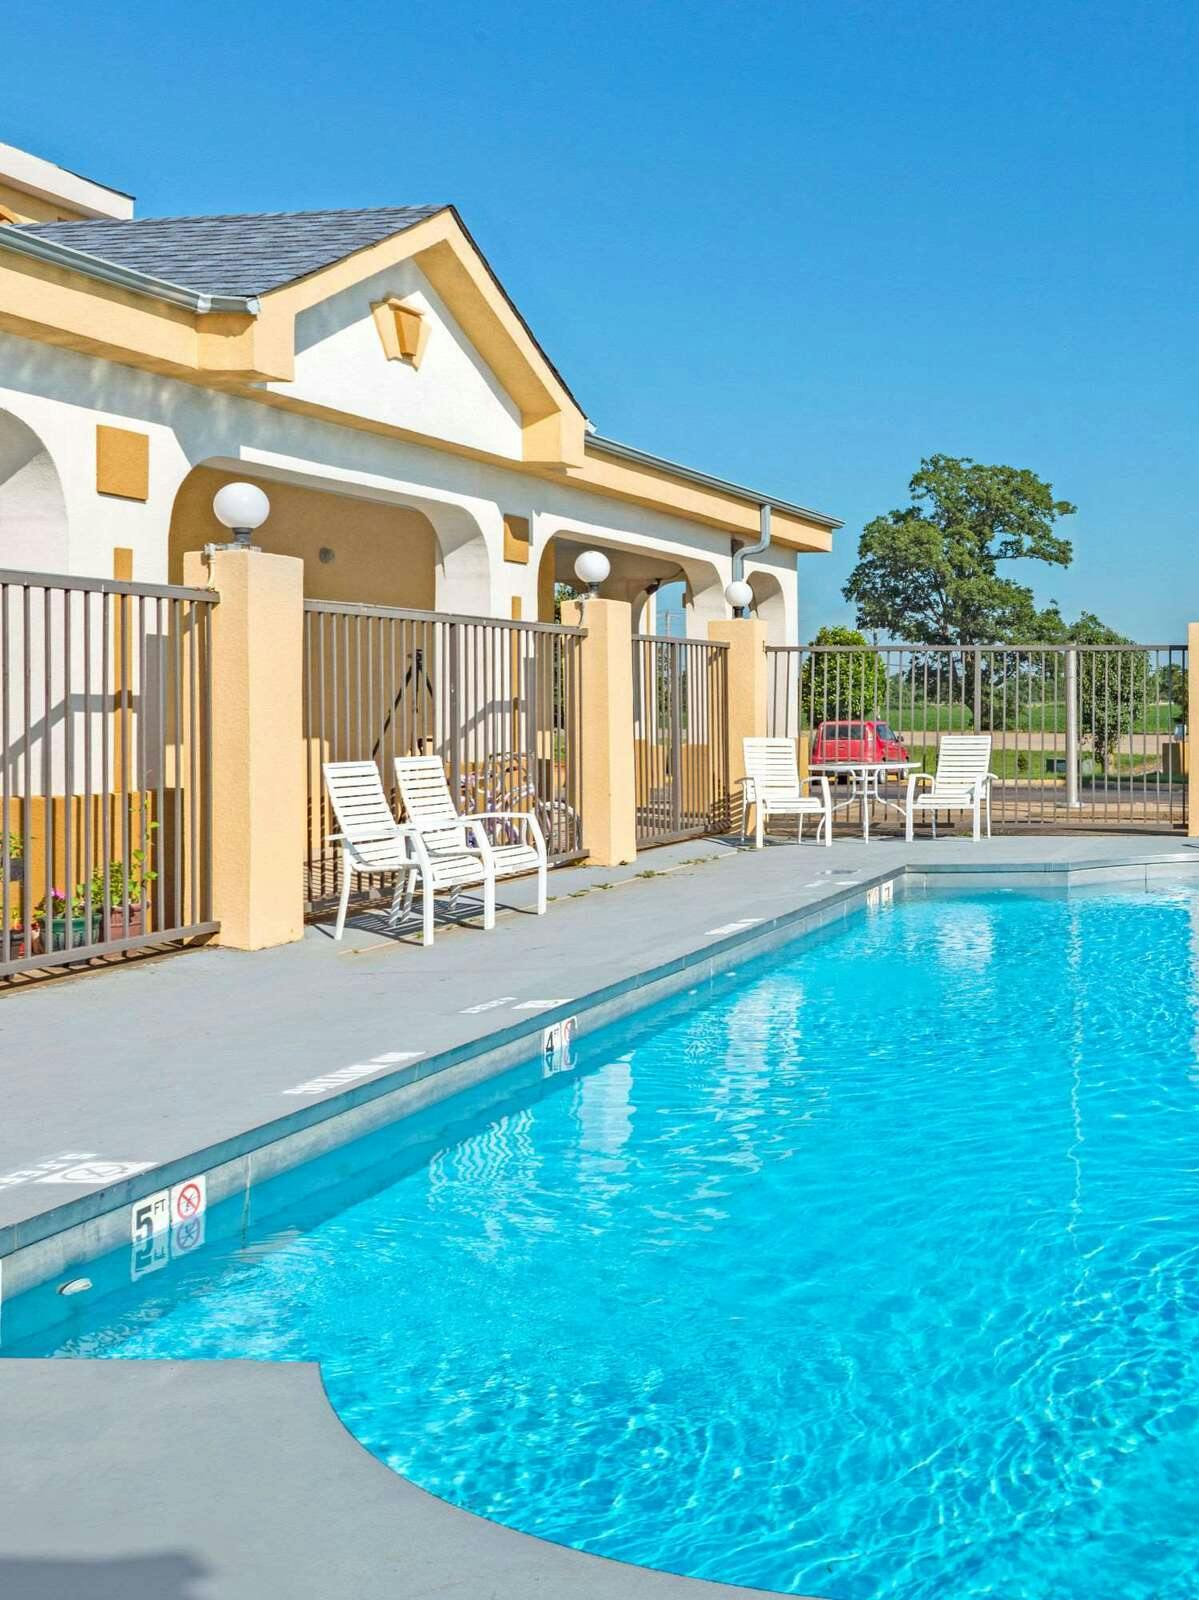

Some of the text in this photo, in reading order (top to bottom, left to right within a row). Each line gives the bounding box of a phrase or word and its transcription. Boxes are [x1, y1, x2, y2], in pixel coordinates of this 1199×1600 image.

[546, 1031, 554, 1052] 4
[136, 1198, 166, 1244] 5 FT
